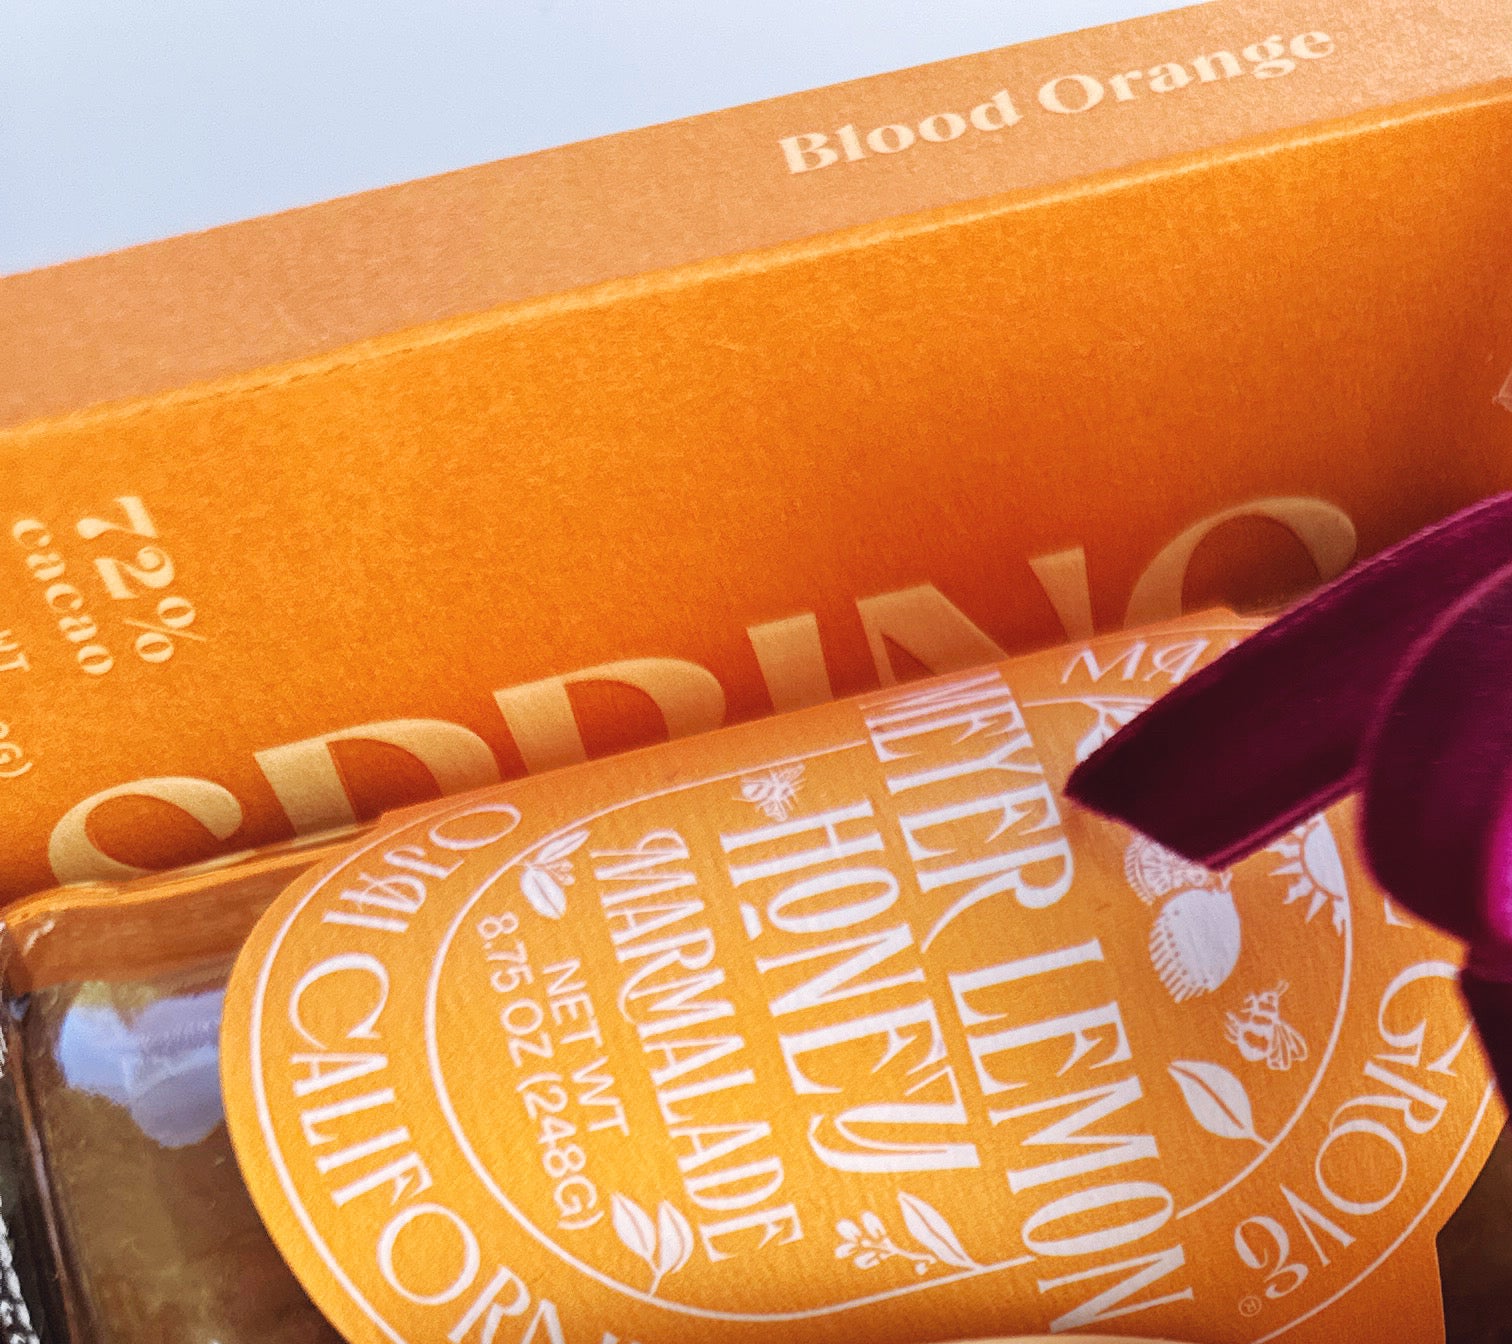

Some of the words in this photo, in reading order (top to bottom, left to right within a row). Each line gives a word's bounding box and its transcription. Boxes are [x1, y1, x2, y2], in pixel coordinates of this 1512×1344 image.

[778, 90, 1022, 175] Blood
[1037, 30, 1336, 114] Orange
[12, 518, 114, 675] cacao
[76, 495, 207, 664] 72%
[860, 671, 1074, 953] MEYER
[476, 911, 535, 993] 8.75
[543, 957, 602, 1048] NET
[720, 799, 981, 1173] HONEY
[500, 998, 555, 1068] OZ
[572, 1055, 630, 1136] WT
[590, 828, 804, 1263] MARMALADE
[516, 1072, 605, 1231] (248G)
[948, 937, 1194, 1334] LEMON
